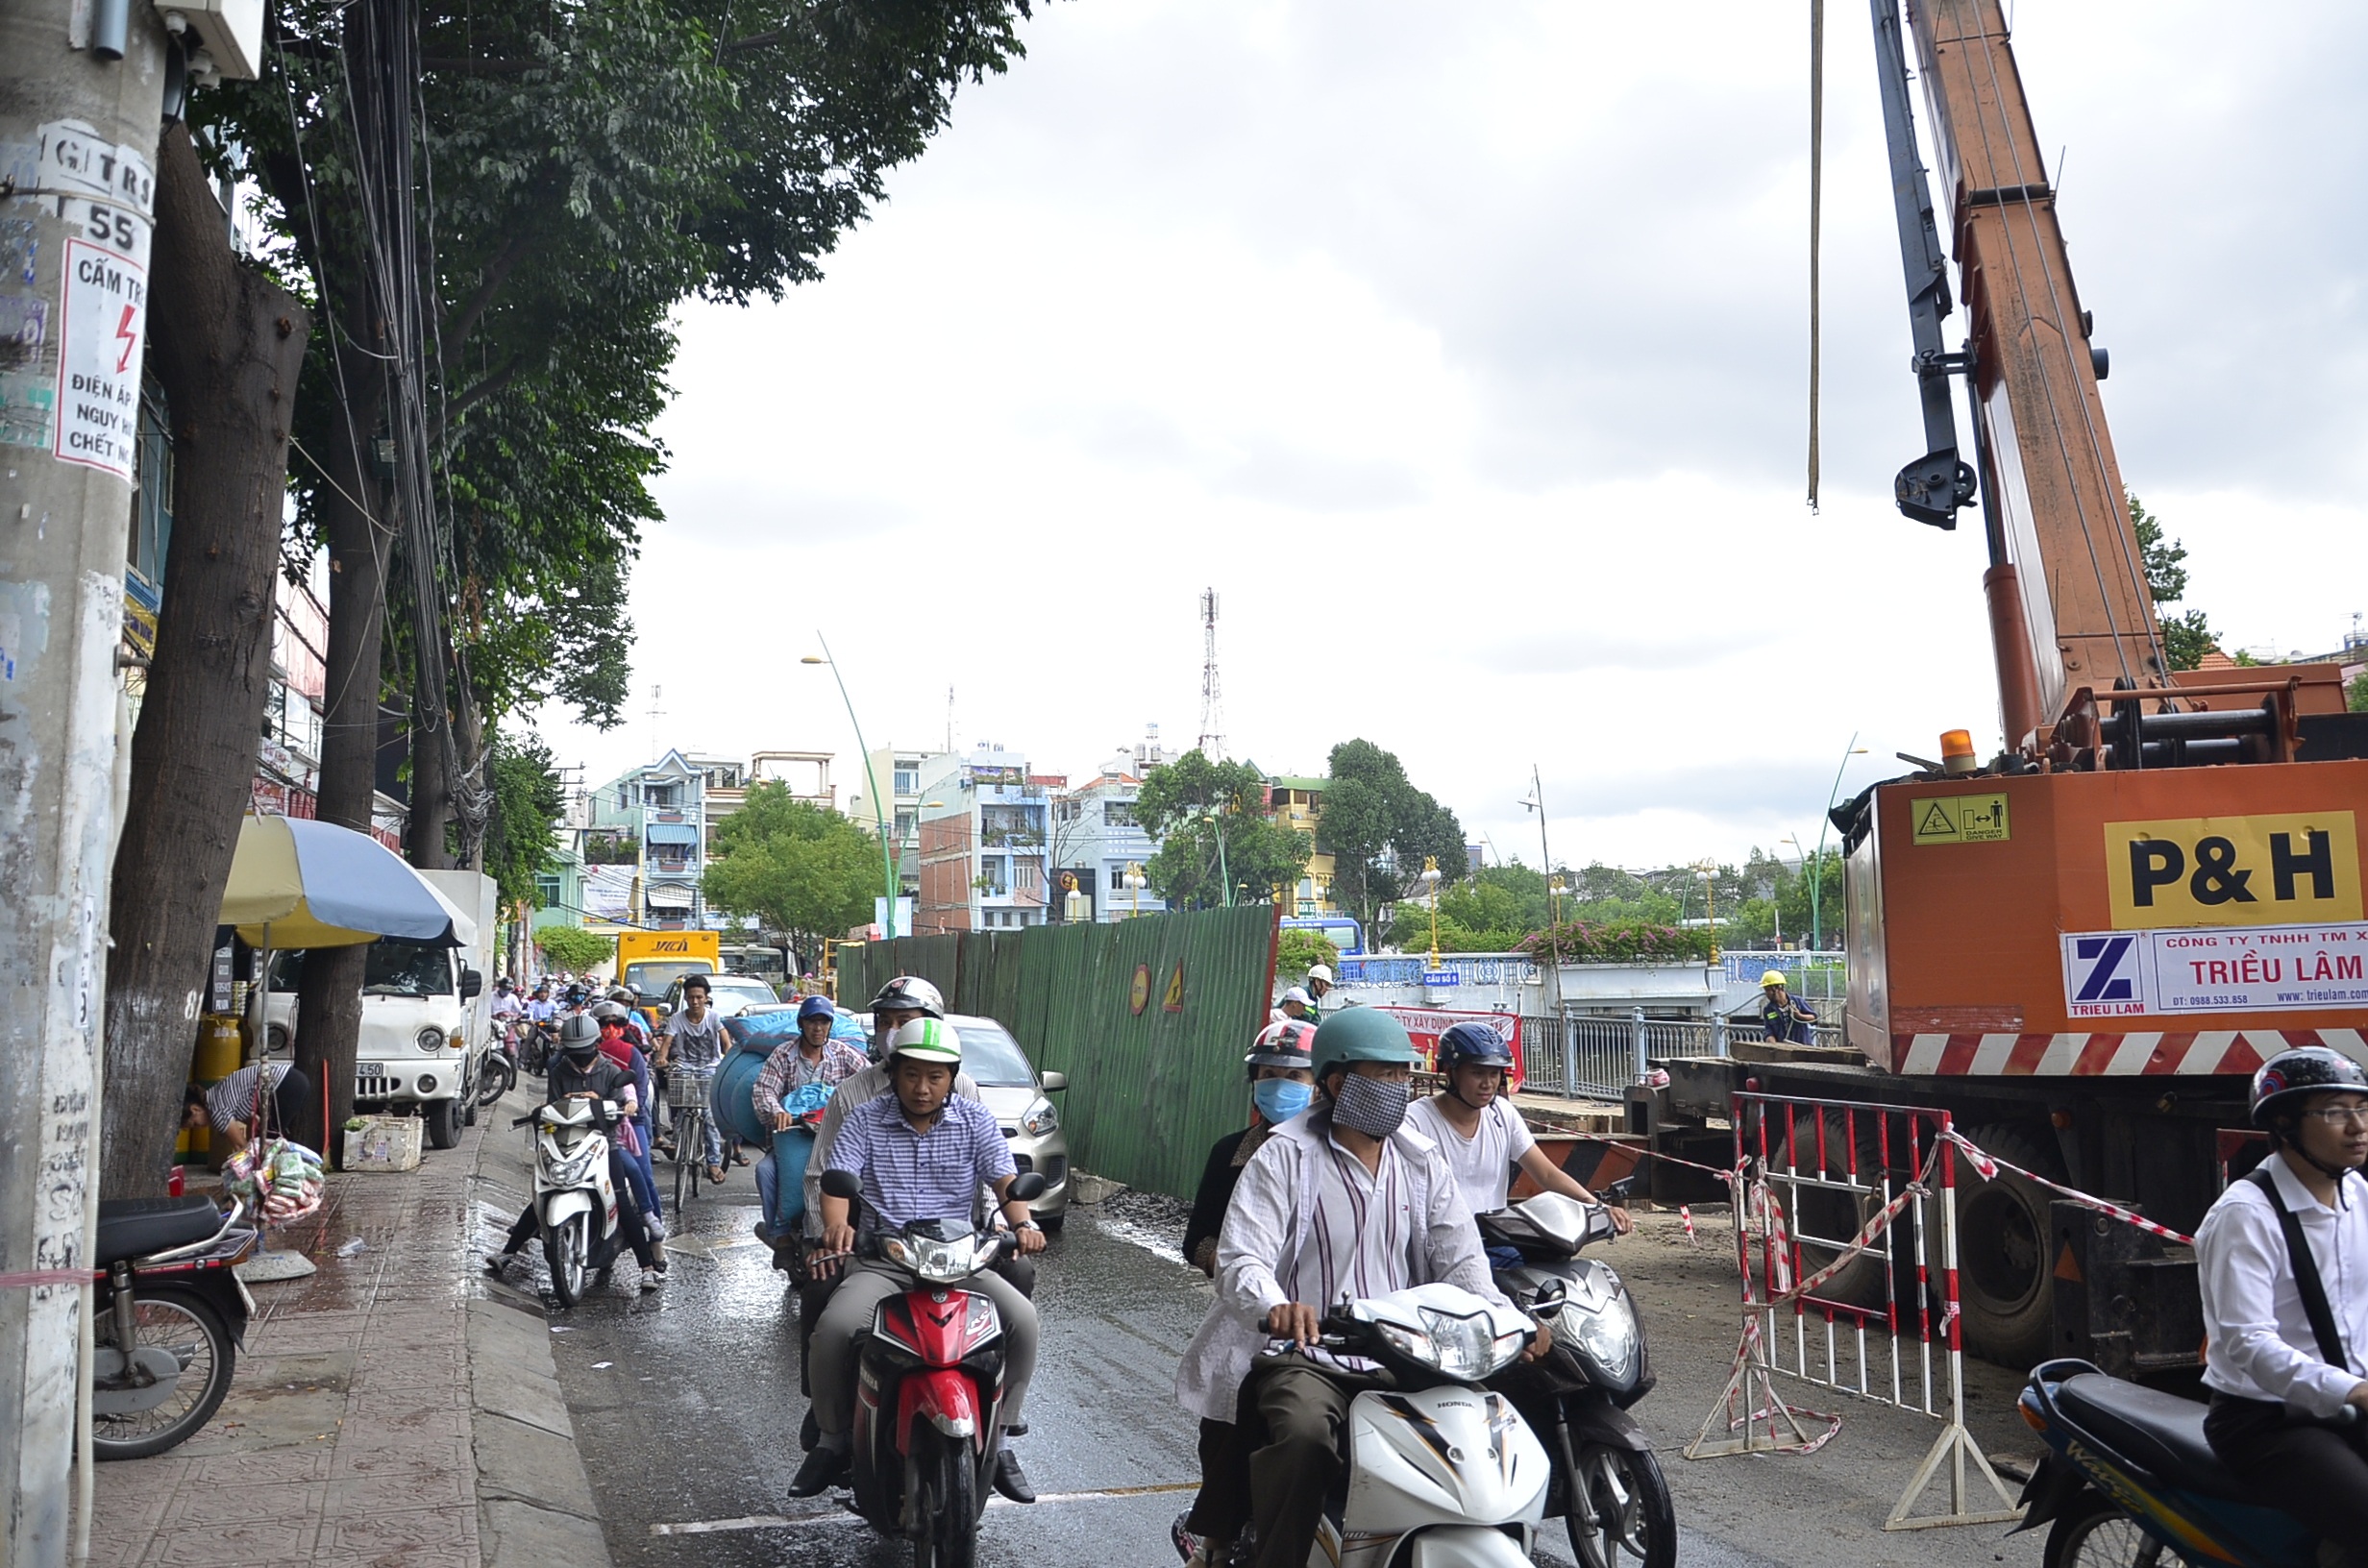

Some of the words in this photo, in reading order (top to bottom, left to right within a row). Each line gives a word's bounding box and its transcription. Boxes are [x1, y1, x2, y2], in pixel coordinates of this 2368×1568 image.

[88, 205, 134, 250] 55
[79, 257, 121, 294] CẤM
[72, 374, 112, 400] ĐIỆN
[77, 404, 119, 429] NGUY
[70, 431, 113, 456] CHẾT
[2166, 936, 2218, 948] CÔNG
[2226, 935, 2249, 945] TY
[2257, 934, 2310, 944] TNHH
[2318, 932, 2347, 943] TM
[2189, 948, 2282, 985] TRIỀU
[2295, 950, 2363, 982] LÂM
[2071, 1004, 2111, 1016] TRIEU
[2116, 1003, 2144, 1015] LAM
[2190, 994, 2248, 1005] 0988.533.858
[1414, 1015, 1429, 1029] XÂY
[1437, 1401, 1476, 1409] HONDA
